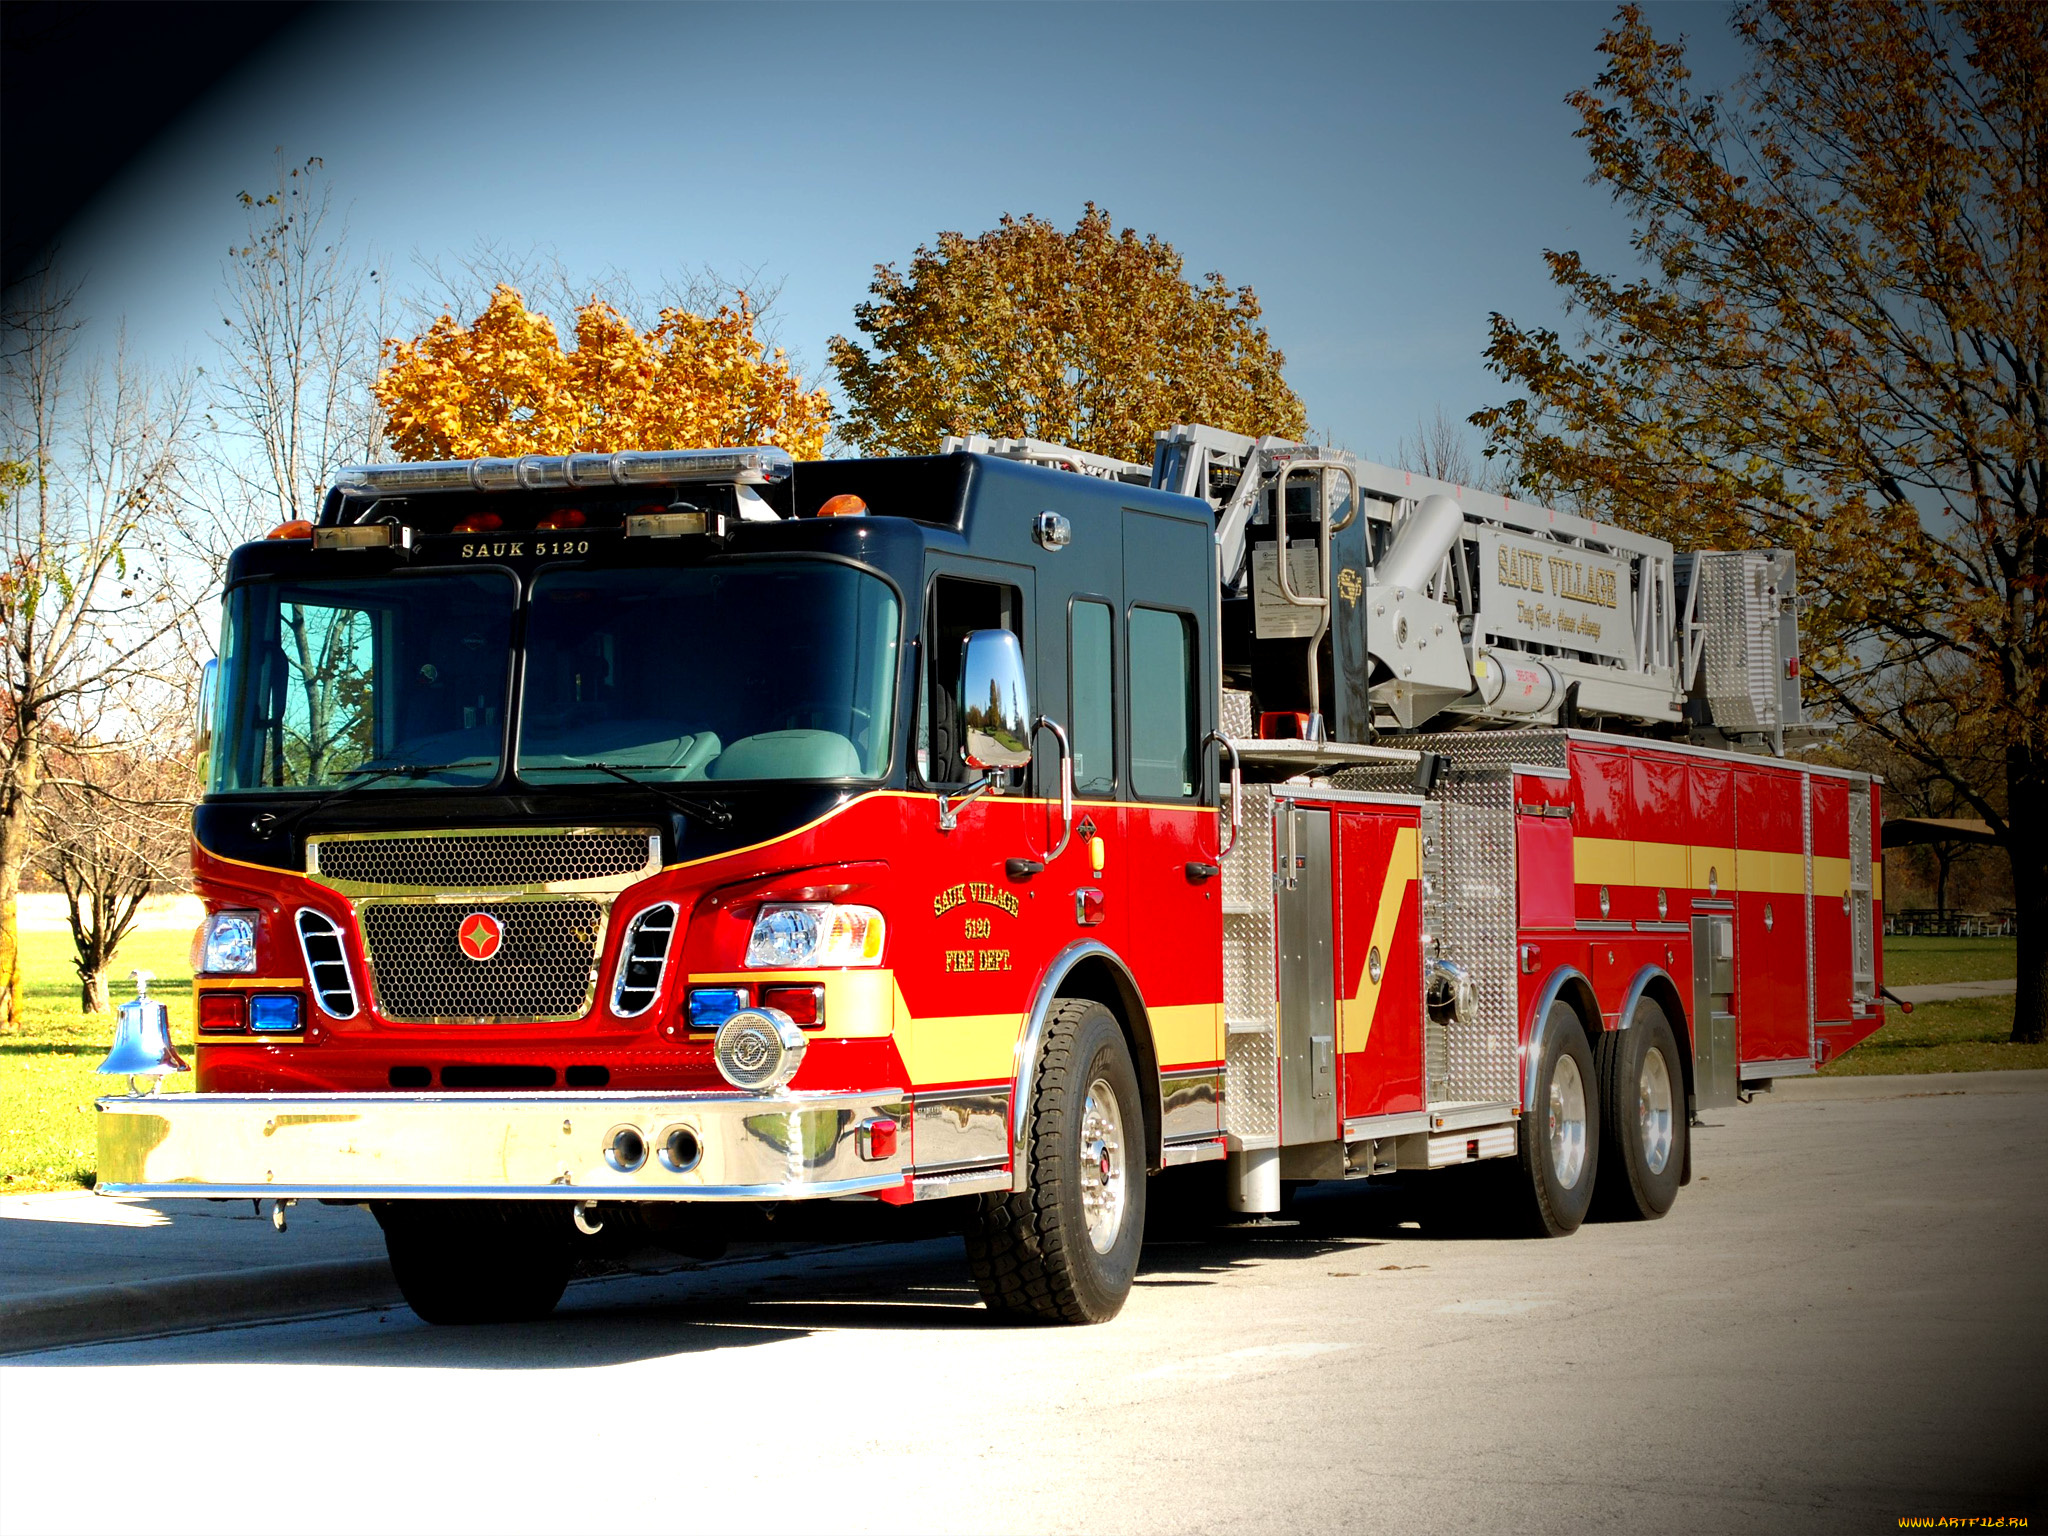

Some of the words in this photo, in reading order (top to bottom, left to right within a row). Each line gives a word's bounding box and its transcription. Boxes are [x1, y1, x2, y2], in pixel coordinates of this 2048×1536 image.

[462, 543, 524, 558] SAUK
[536, 541, 589, 556] 5120
[1498, 544, 1544, 594] SAUK
[1548, 555, 1617, 609] VILLAGE
[934, 883, 966, 918] SAUK
[969, 882, 1019, 918] VILLAGE
[965, 918, 990, 939] 5120
[945, 950, 975, 972] FIRE
